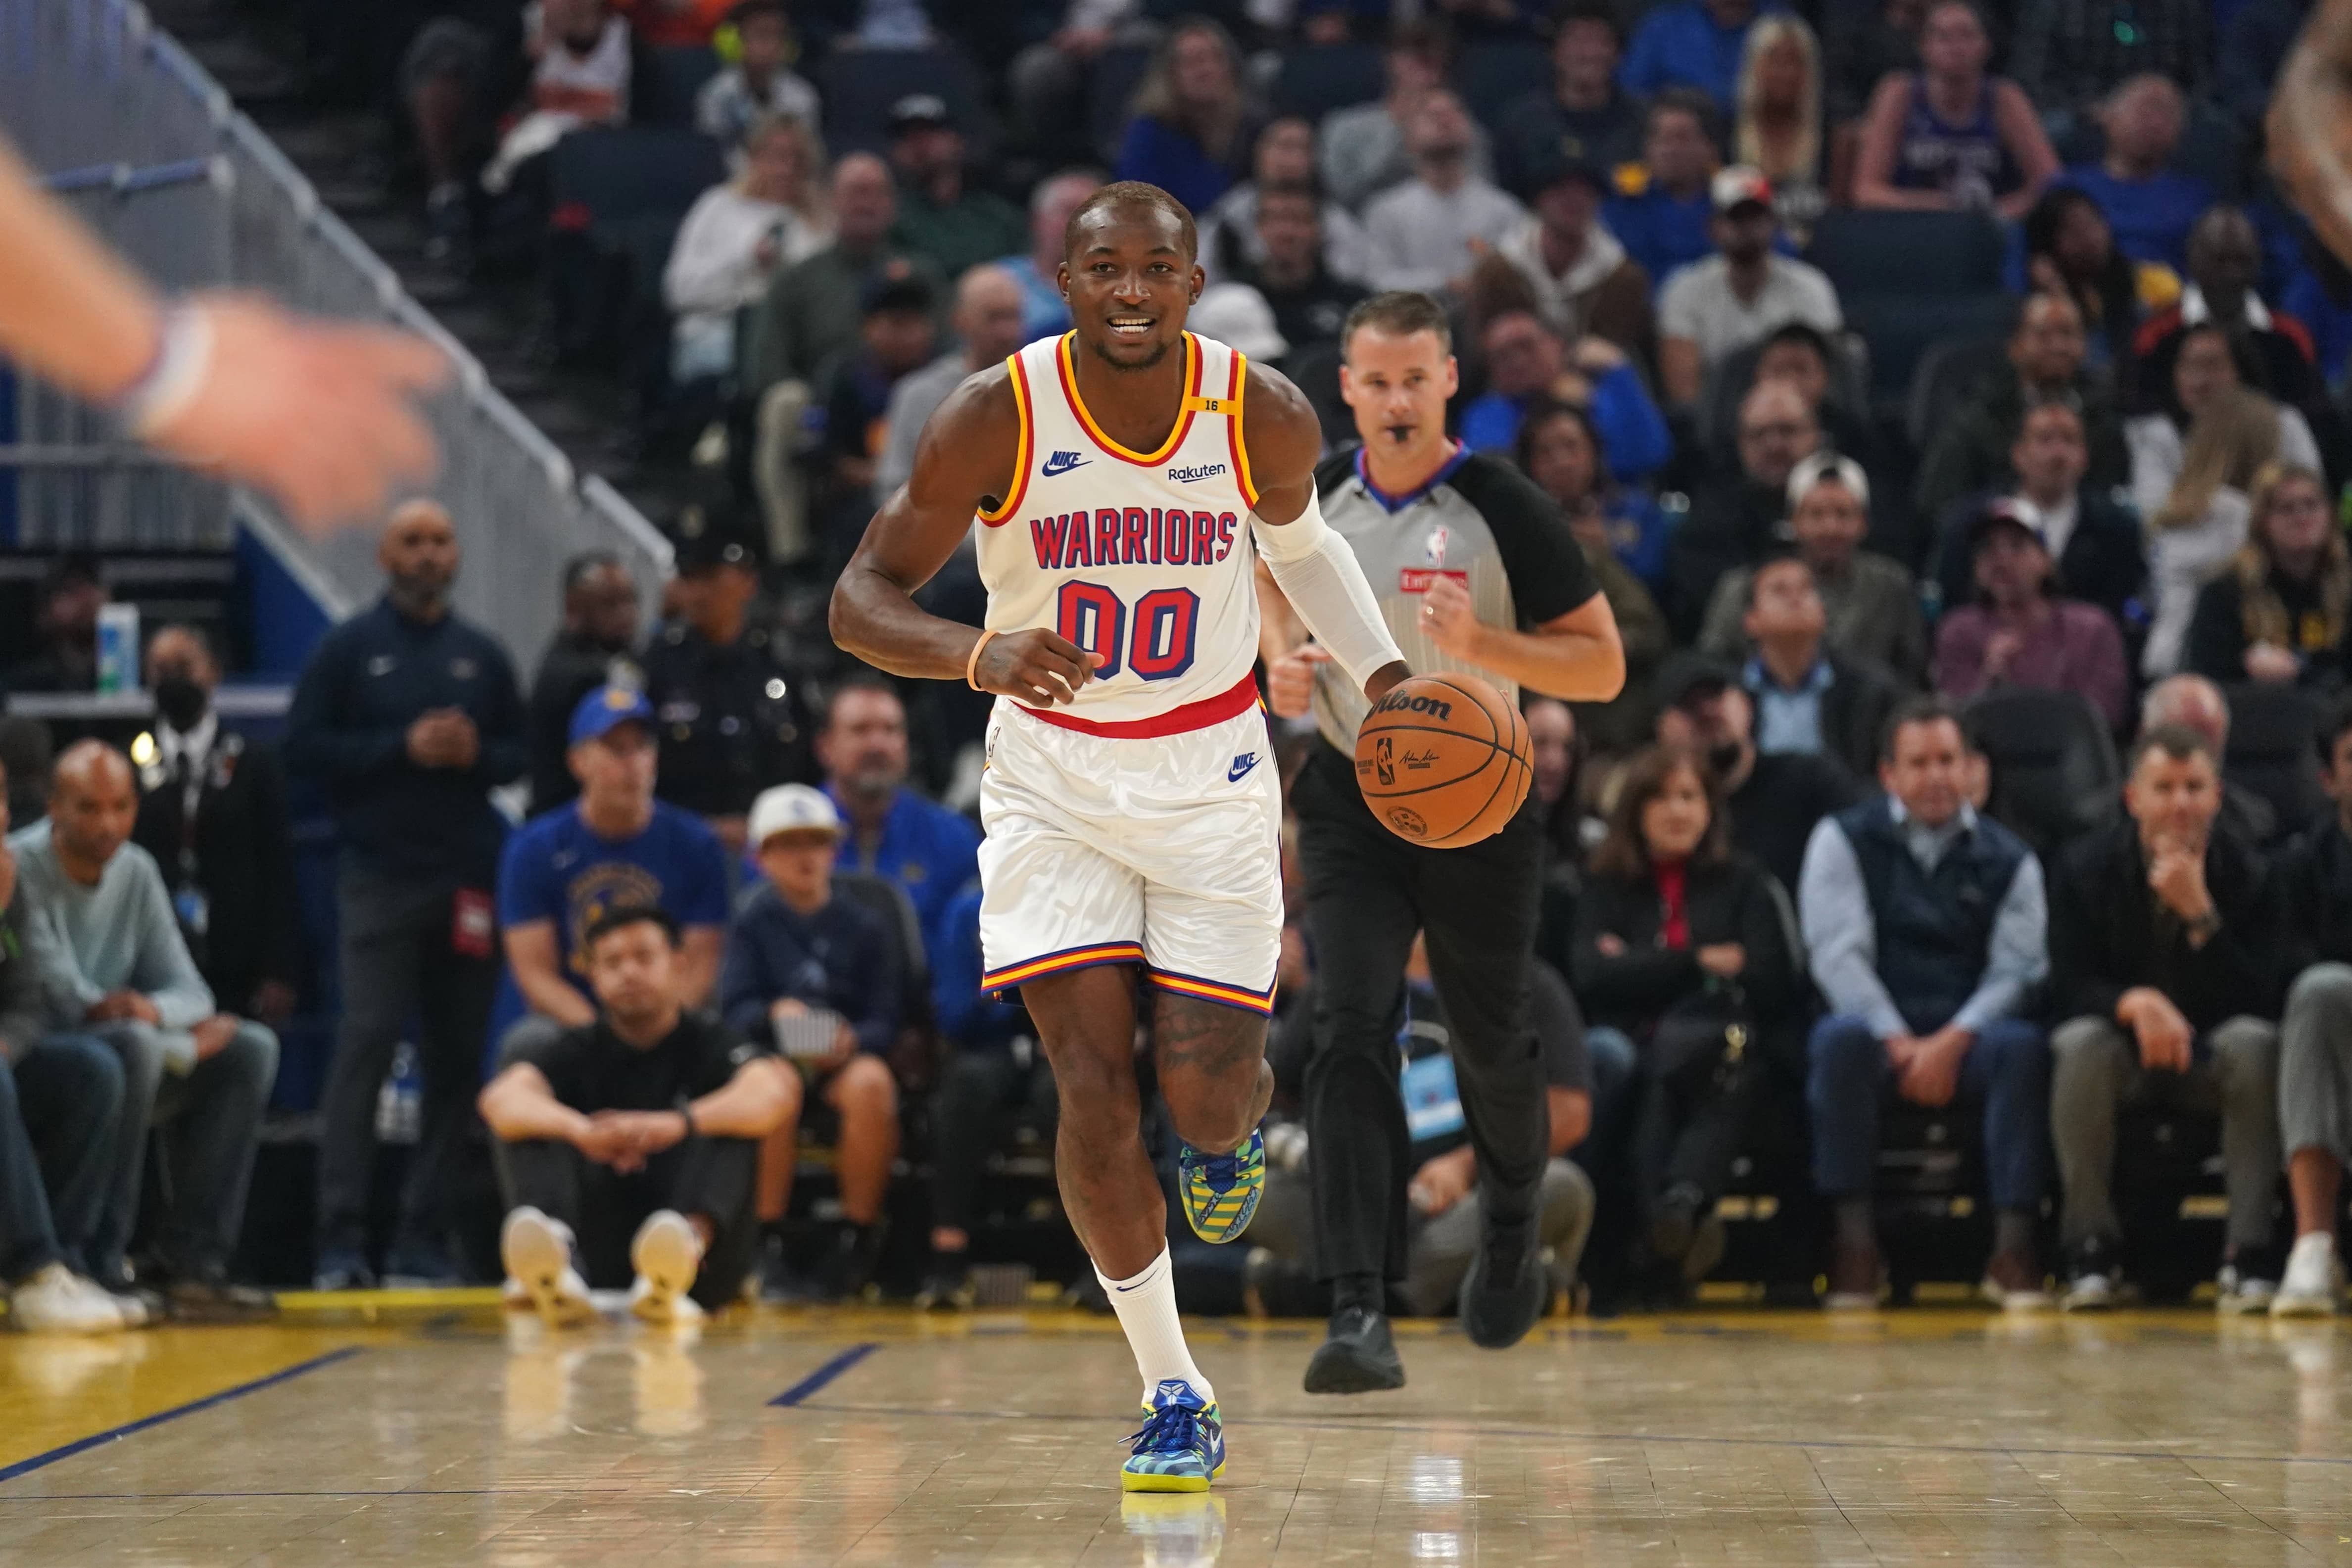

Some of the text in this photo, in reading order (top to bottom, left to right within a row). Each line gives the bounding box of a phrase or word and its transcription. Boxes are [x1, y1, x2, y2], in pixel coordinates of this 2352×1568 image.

[1205, 400, 1218, 411] 16
[1049, 451, 1081, 467] NIKE
[1168, 464, 1226, 480] Rakuten
[1030, 507, 1237, 569] WARRIORS
[1057, 579, 1200, 681] 00
[1232, 752, 1255, 771] NIKE
